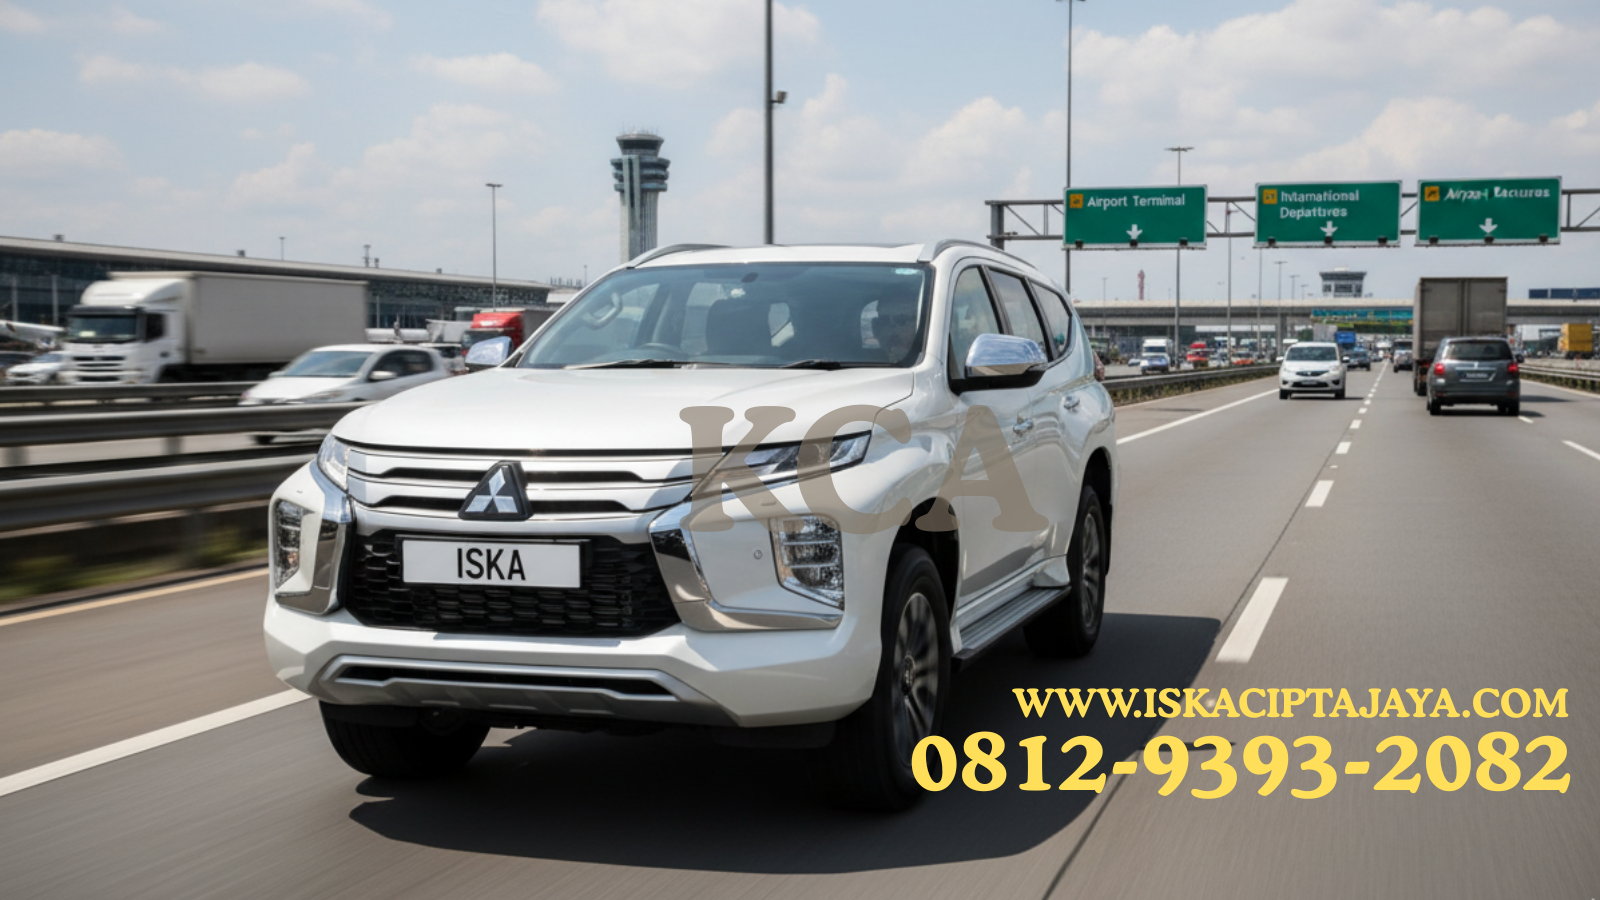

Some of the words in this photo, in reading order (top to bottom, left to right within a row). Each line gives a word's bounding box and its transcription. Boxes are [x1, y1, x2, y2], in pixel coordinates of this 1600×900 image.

[1087, 196, 1127, 211] Airport
[1132, 193, 1186, 207] Terminal
[456, 547, 526, 581] ISKA
